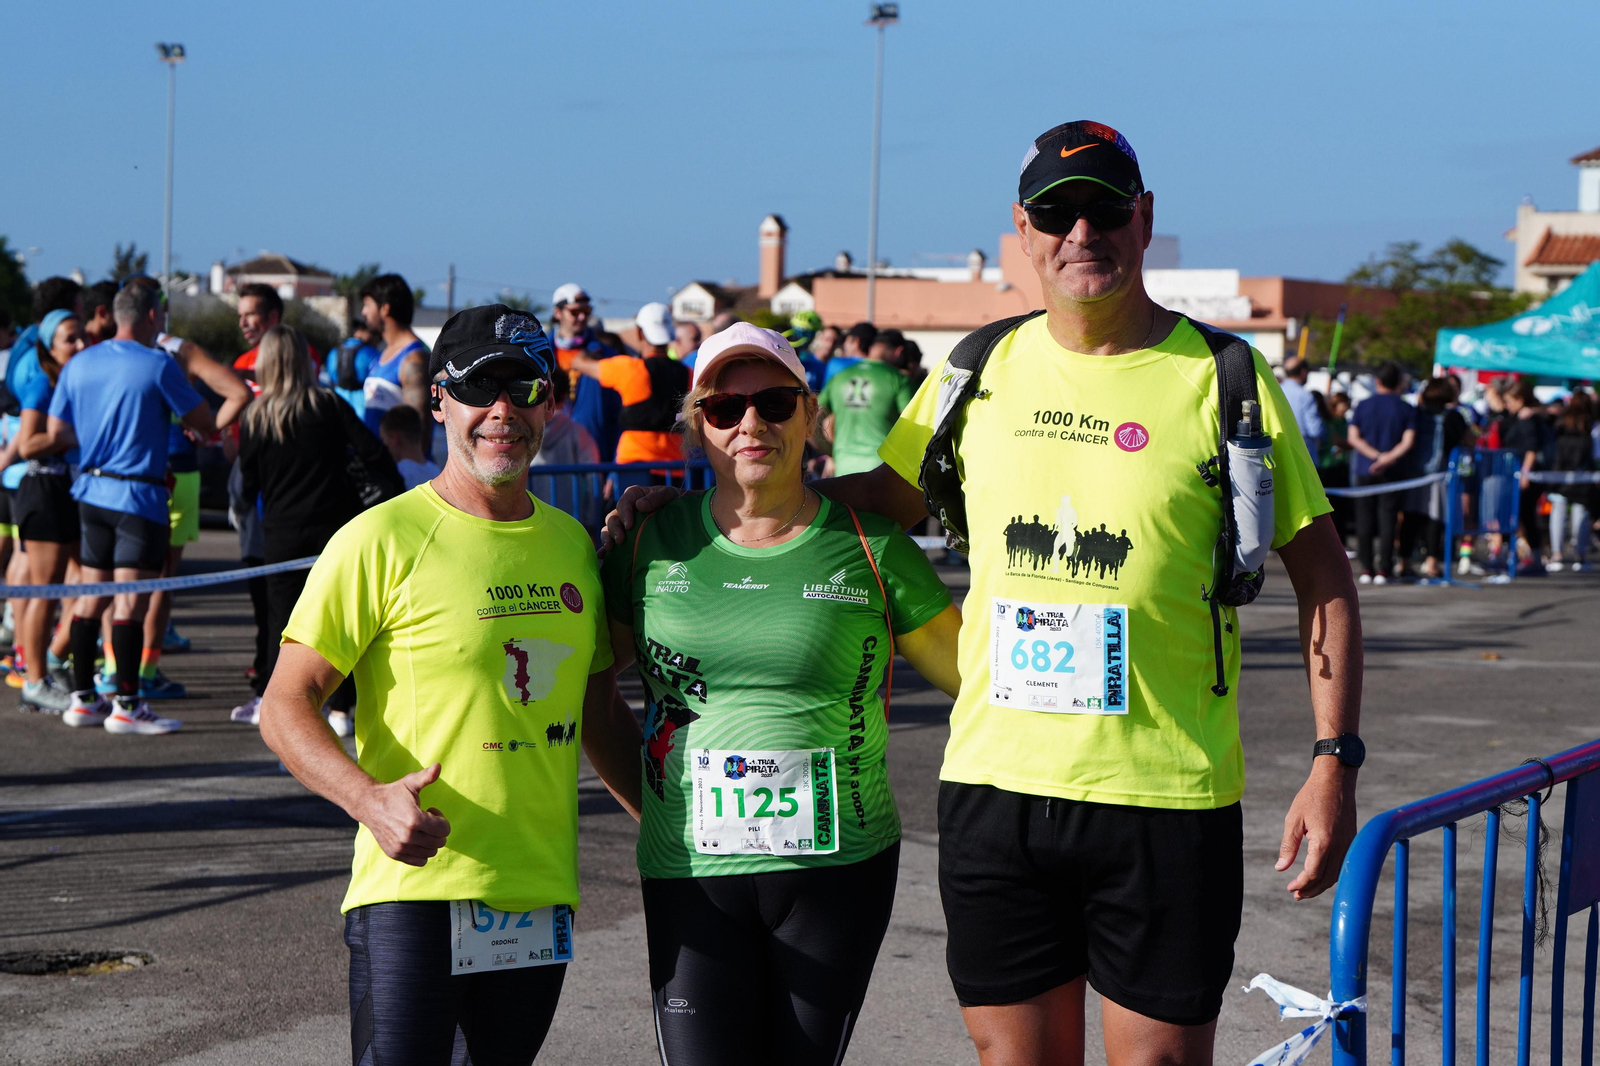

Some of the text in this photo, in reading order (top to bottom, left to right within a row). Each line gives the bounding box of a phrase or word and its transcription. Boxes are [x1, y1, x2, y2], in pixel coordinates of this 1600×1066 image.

[1033, 410, 1110, 432] 1000 Km
[1014, 428, 1109, 445] contra el CÁNCER
[486, 583, 555, 601] 1000 Km
[655, 585, 689, 594] INAUTO
[722, 582, 770, 590] TEAMERGY
[803, 583, 869, 597] LIBERTIUM
[806, 592, 867, 604] AUTOCARAVANAS
[477, 600, 561, 616] contra el CÁNCER
[1034, 618, 1069, 628] PIRATA
[647, 637, 703, 677] TRAIL
[1010, 638, 1076, 674] 682
[1107, 613, 1122, 706] PIRATILLA
[1025, 680, 1059, 688] CLEMENTE
[848, 635, 878, 752] CAMINATA
[697, 756, 710, 766] 10
[746, 766, 780, 774] PIRATA
[710, 786, 799, 818] 1125
[814, 756, 832, 846] CAMINATA
[555, 904, 569, 955] PIRAT
[491, 938, 519, 946] ORDOÑEZ
